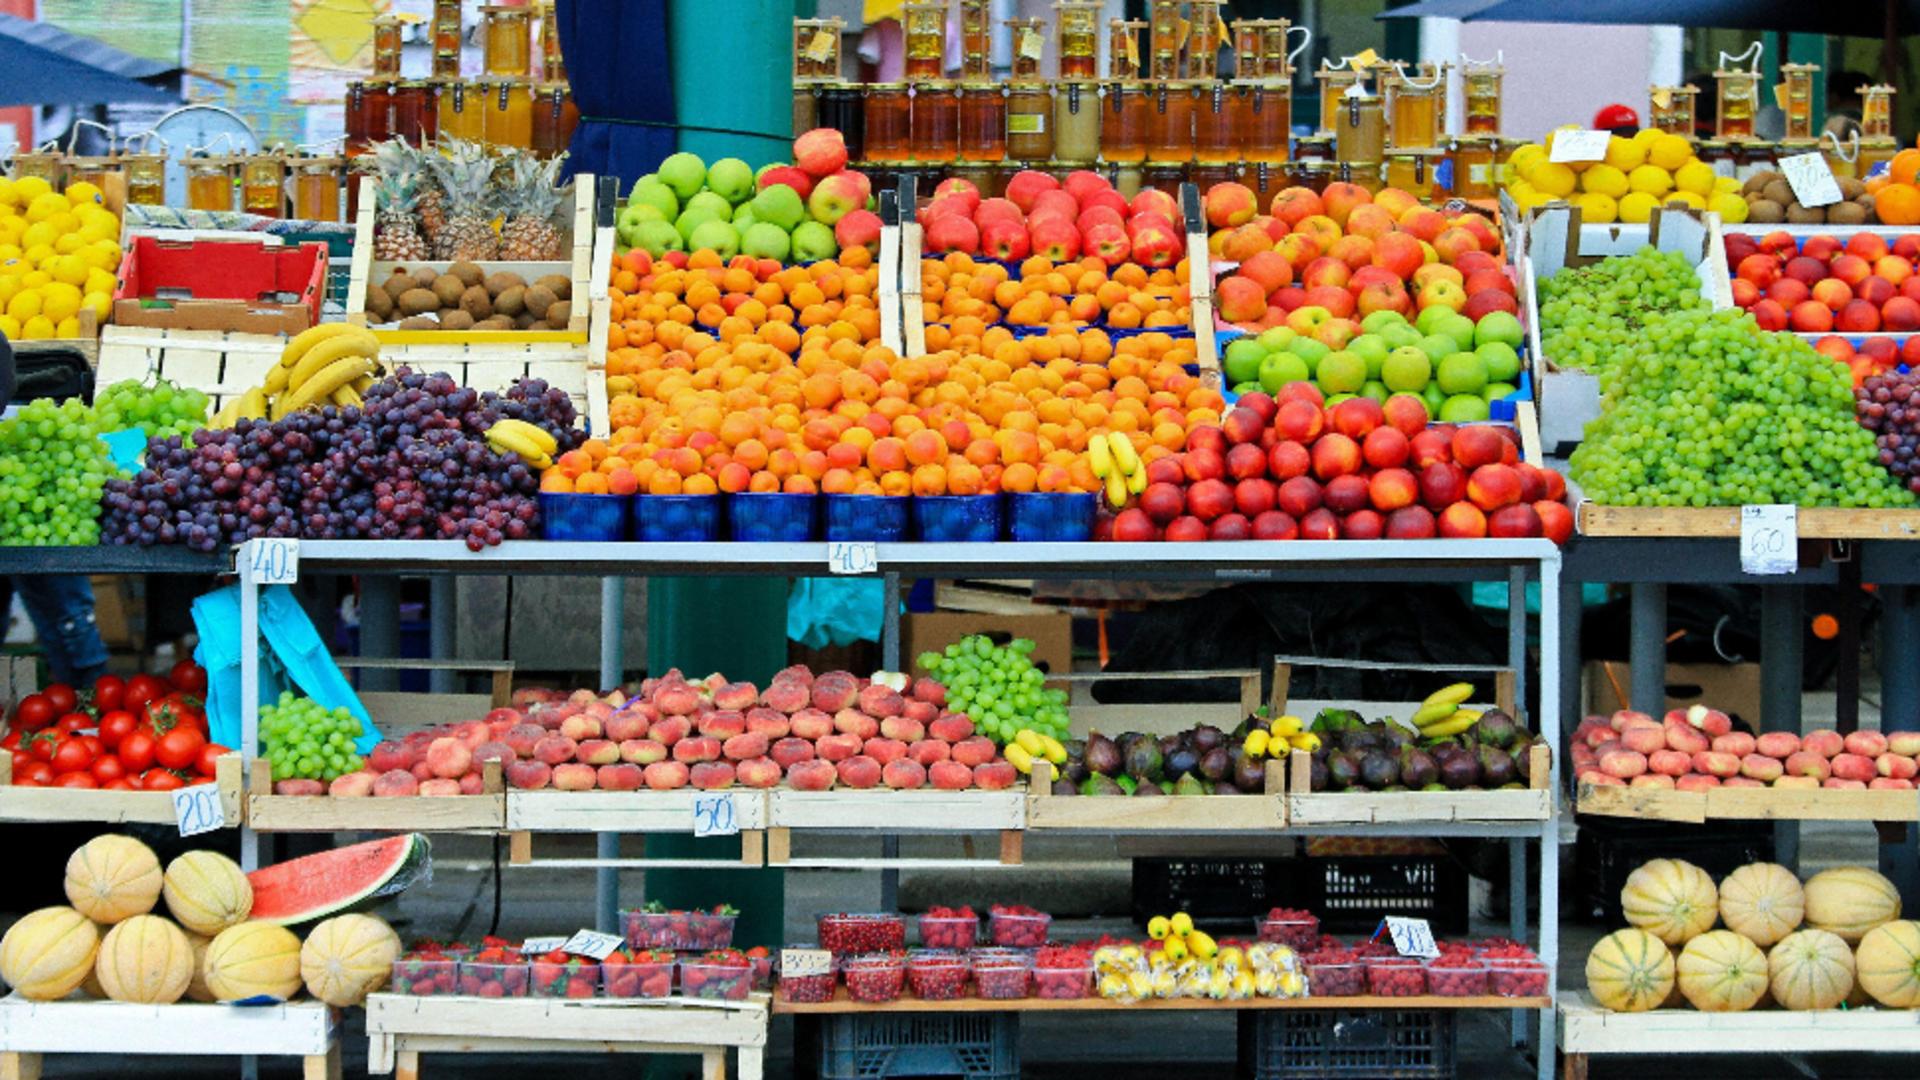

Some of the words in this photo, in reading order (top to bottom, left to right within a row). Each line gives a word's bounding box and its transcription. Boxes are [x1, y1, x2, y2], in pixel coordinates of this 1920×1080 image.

[253, 540, 286, 581] 40
[834, 543, 867, 570] 40
[1751, 527, 1784, 559] 60
[177, 791, 214, 834] 20
[696, 798, 731, 833] 50
